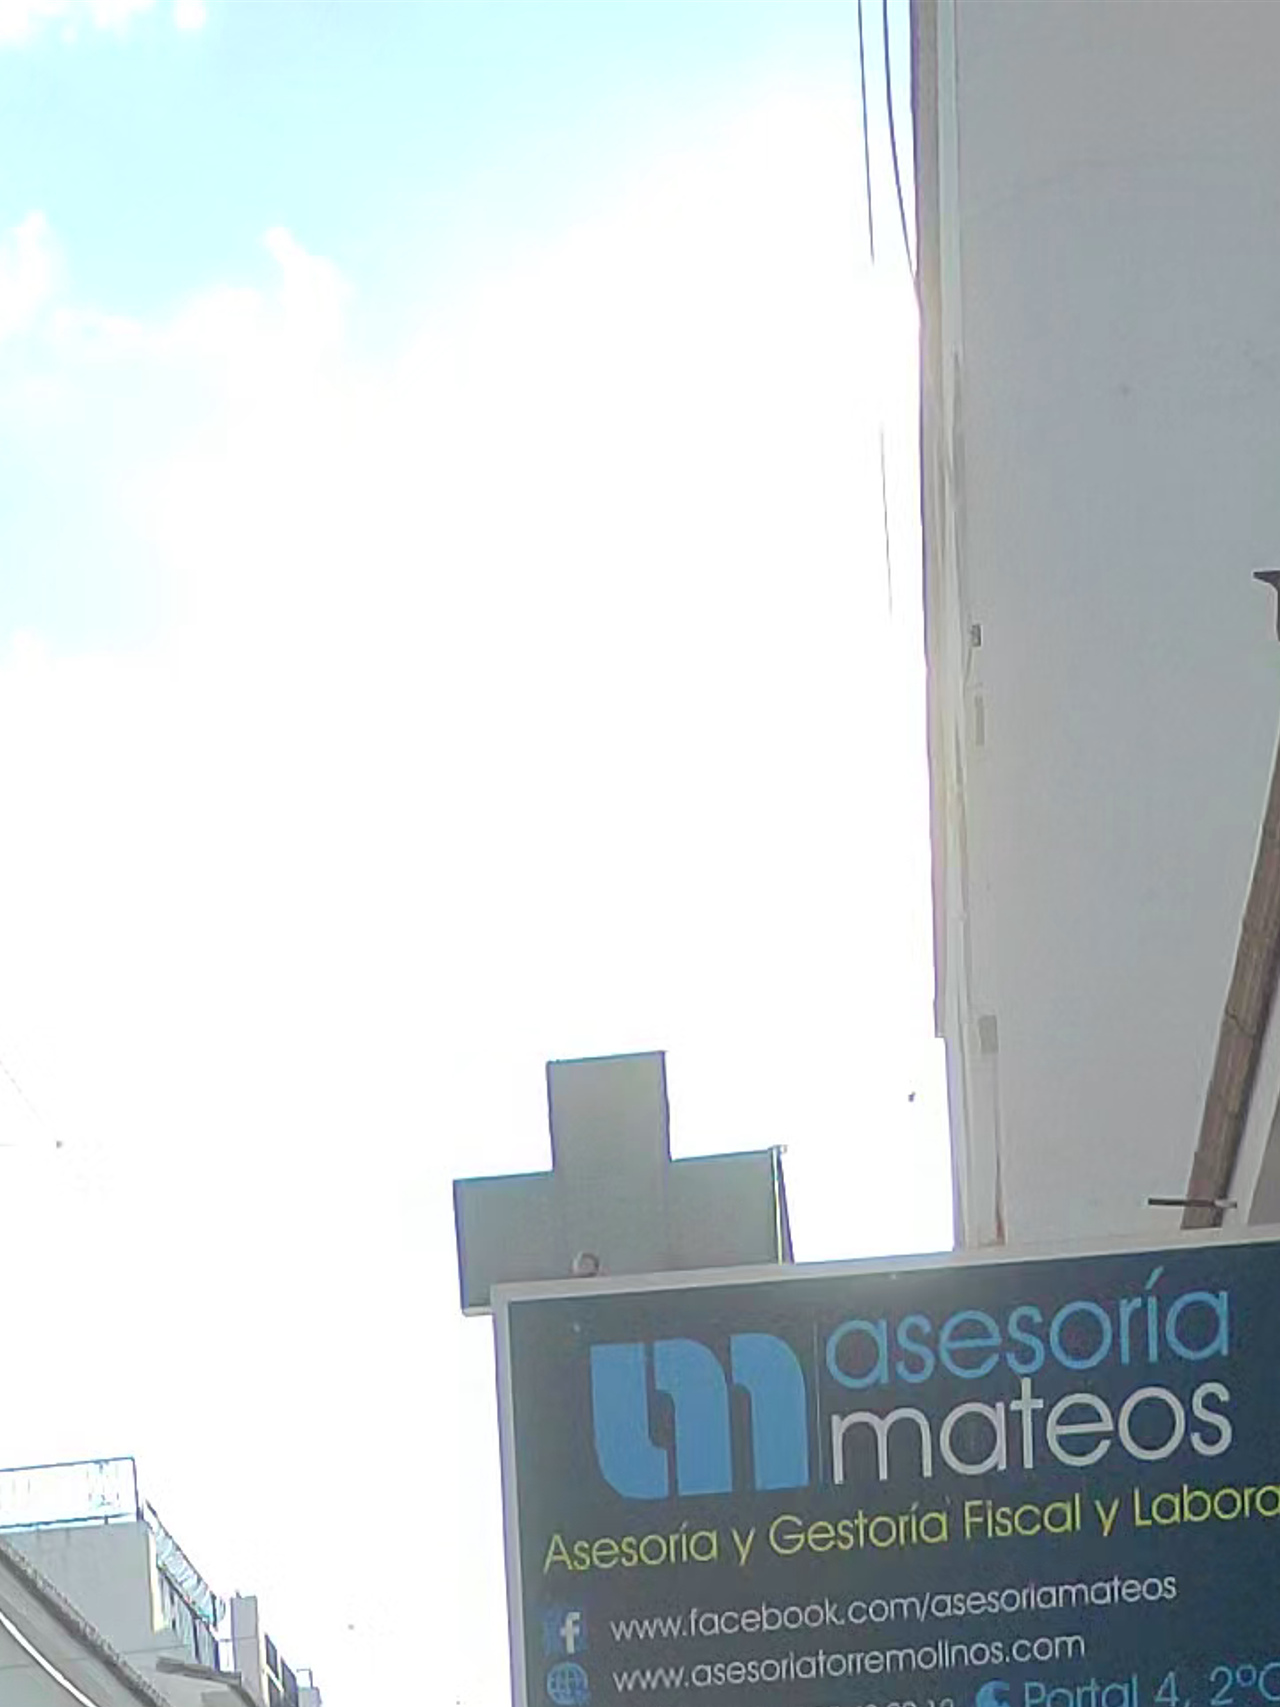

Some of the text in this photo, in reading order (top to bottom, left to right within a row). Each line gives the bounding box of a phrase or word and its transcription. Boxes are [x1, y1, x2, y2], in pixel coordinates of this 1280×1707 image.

[824, 1266, 1231, 1392] asesoría
[831, 1374, 1234, 1486] mateos
[543, 1520, 718, 1575] Asesoría
[730, 1526, 756, 1567] y
[768, 1502, 949, 1556] Gestoría
[964, 1492, 1082, 1539] Fiscal
[1095, 1497, 1120, 1537] y
[610, 1575, 1178, 1642] www.facebook.com/asesoriamateos
[612, 1634, 1086, 1693] www.asesoriatorremolinos.com
